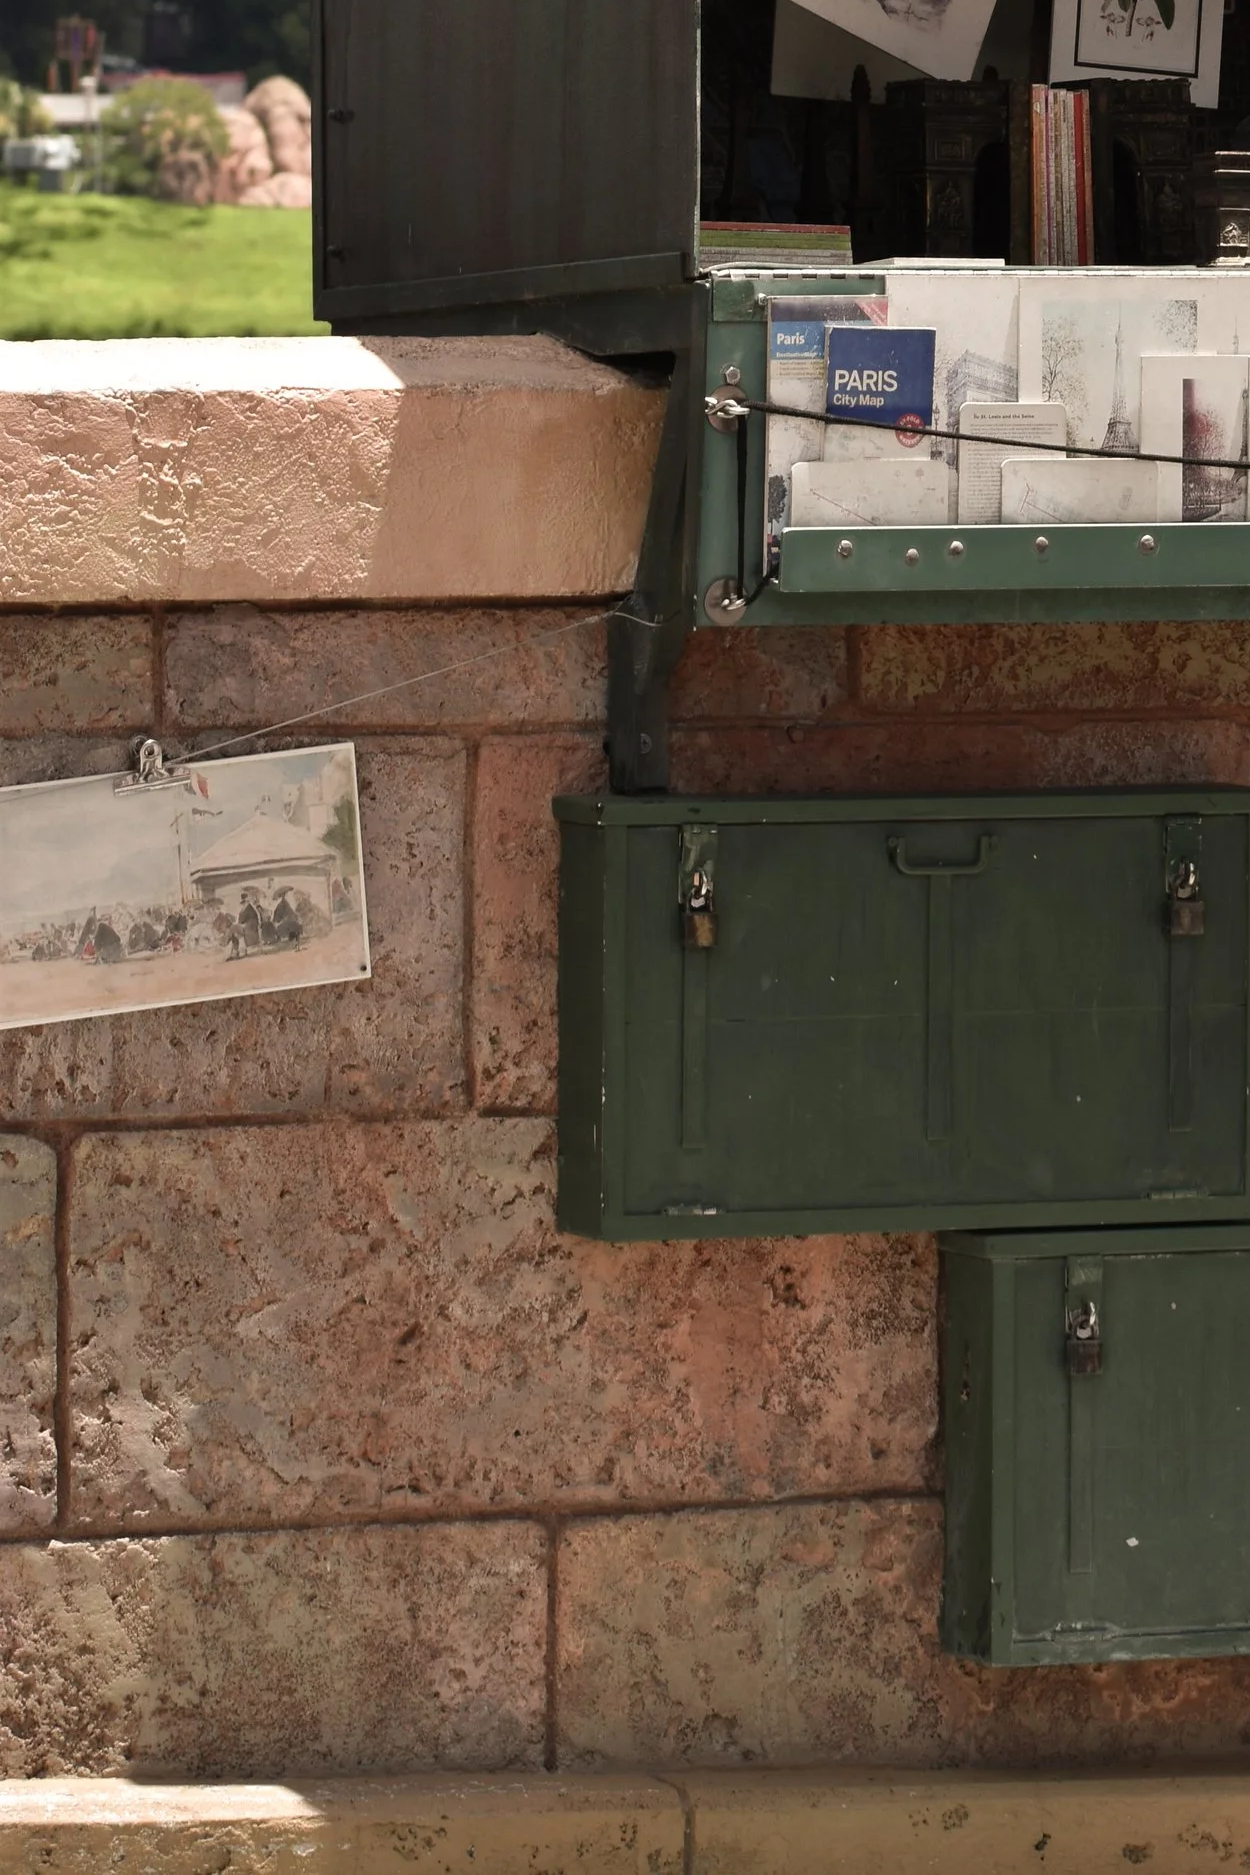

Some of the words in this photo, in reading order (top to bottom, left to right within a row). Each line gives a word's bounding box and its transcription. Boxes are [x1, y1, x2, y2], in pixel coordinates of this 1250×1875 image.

[776, 332, 805, 345] Paris
[834, 369, 898, 392] PARIS
[833, 393, 857, 408] City
[859, 394, 884, 408] Map
